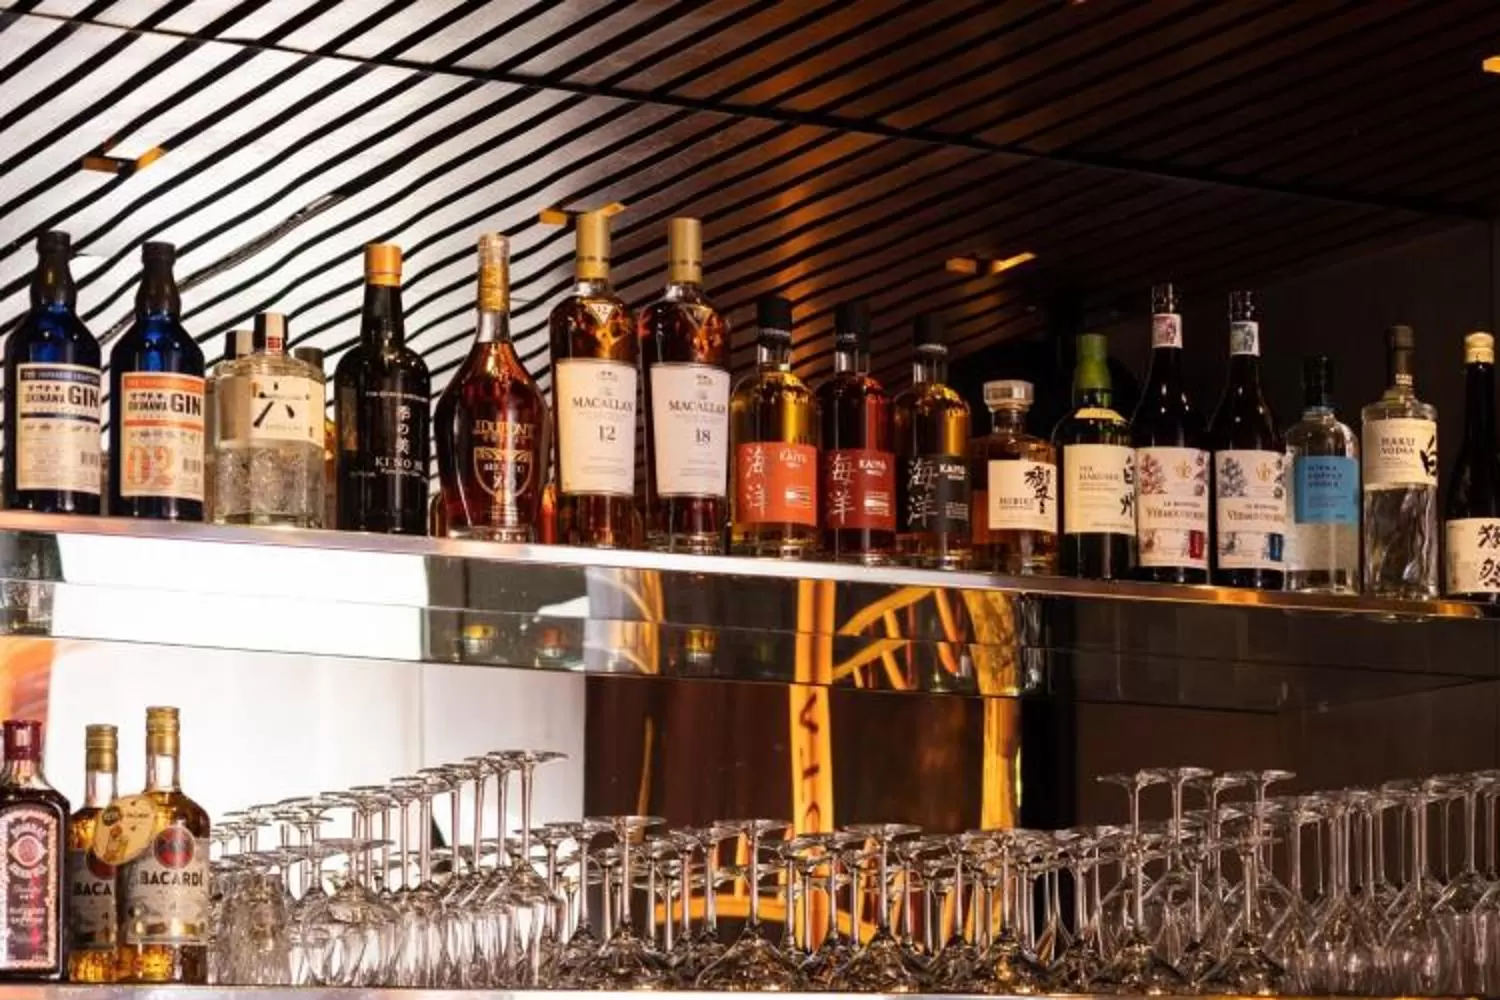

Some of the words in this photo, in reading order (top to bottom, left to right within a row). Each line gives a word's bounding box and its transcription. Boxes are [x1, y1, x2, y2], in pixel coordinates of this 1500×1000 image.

[68, 384, 99, 409] GIN
[171, 393, 202, 417] GIN
[599, 425, 617, 441] 12
[695, 428, 712, 444] 18
[73, 882, 113, 897] BACA
